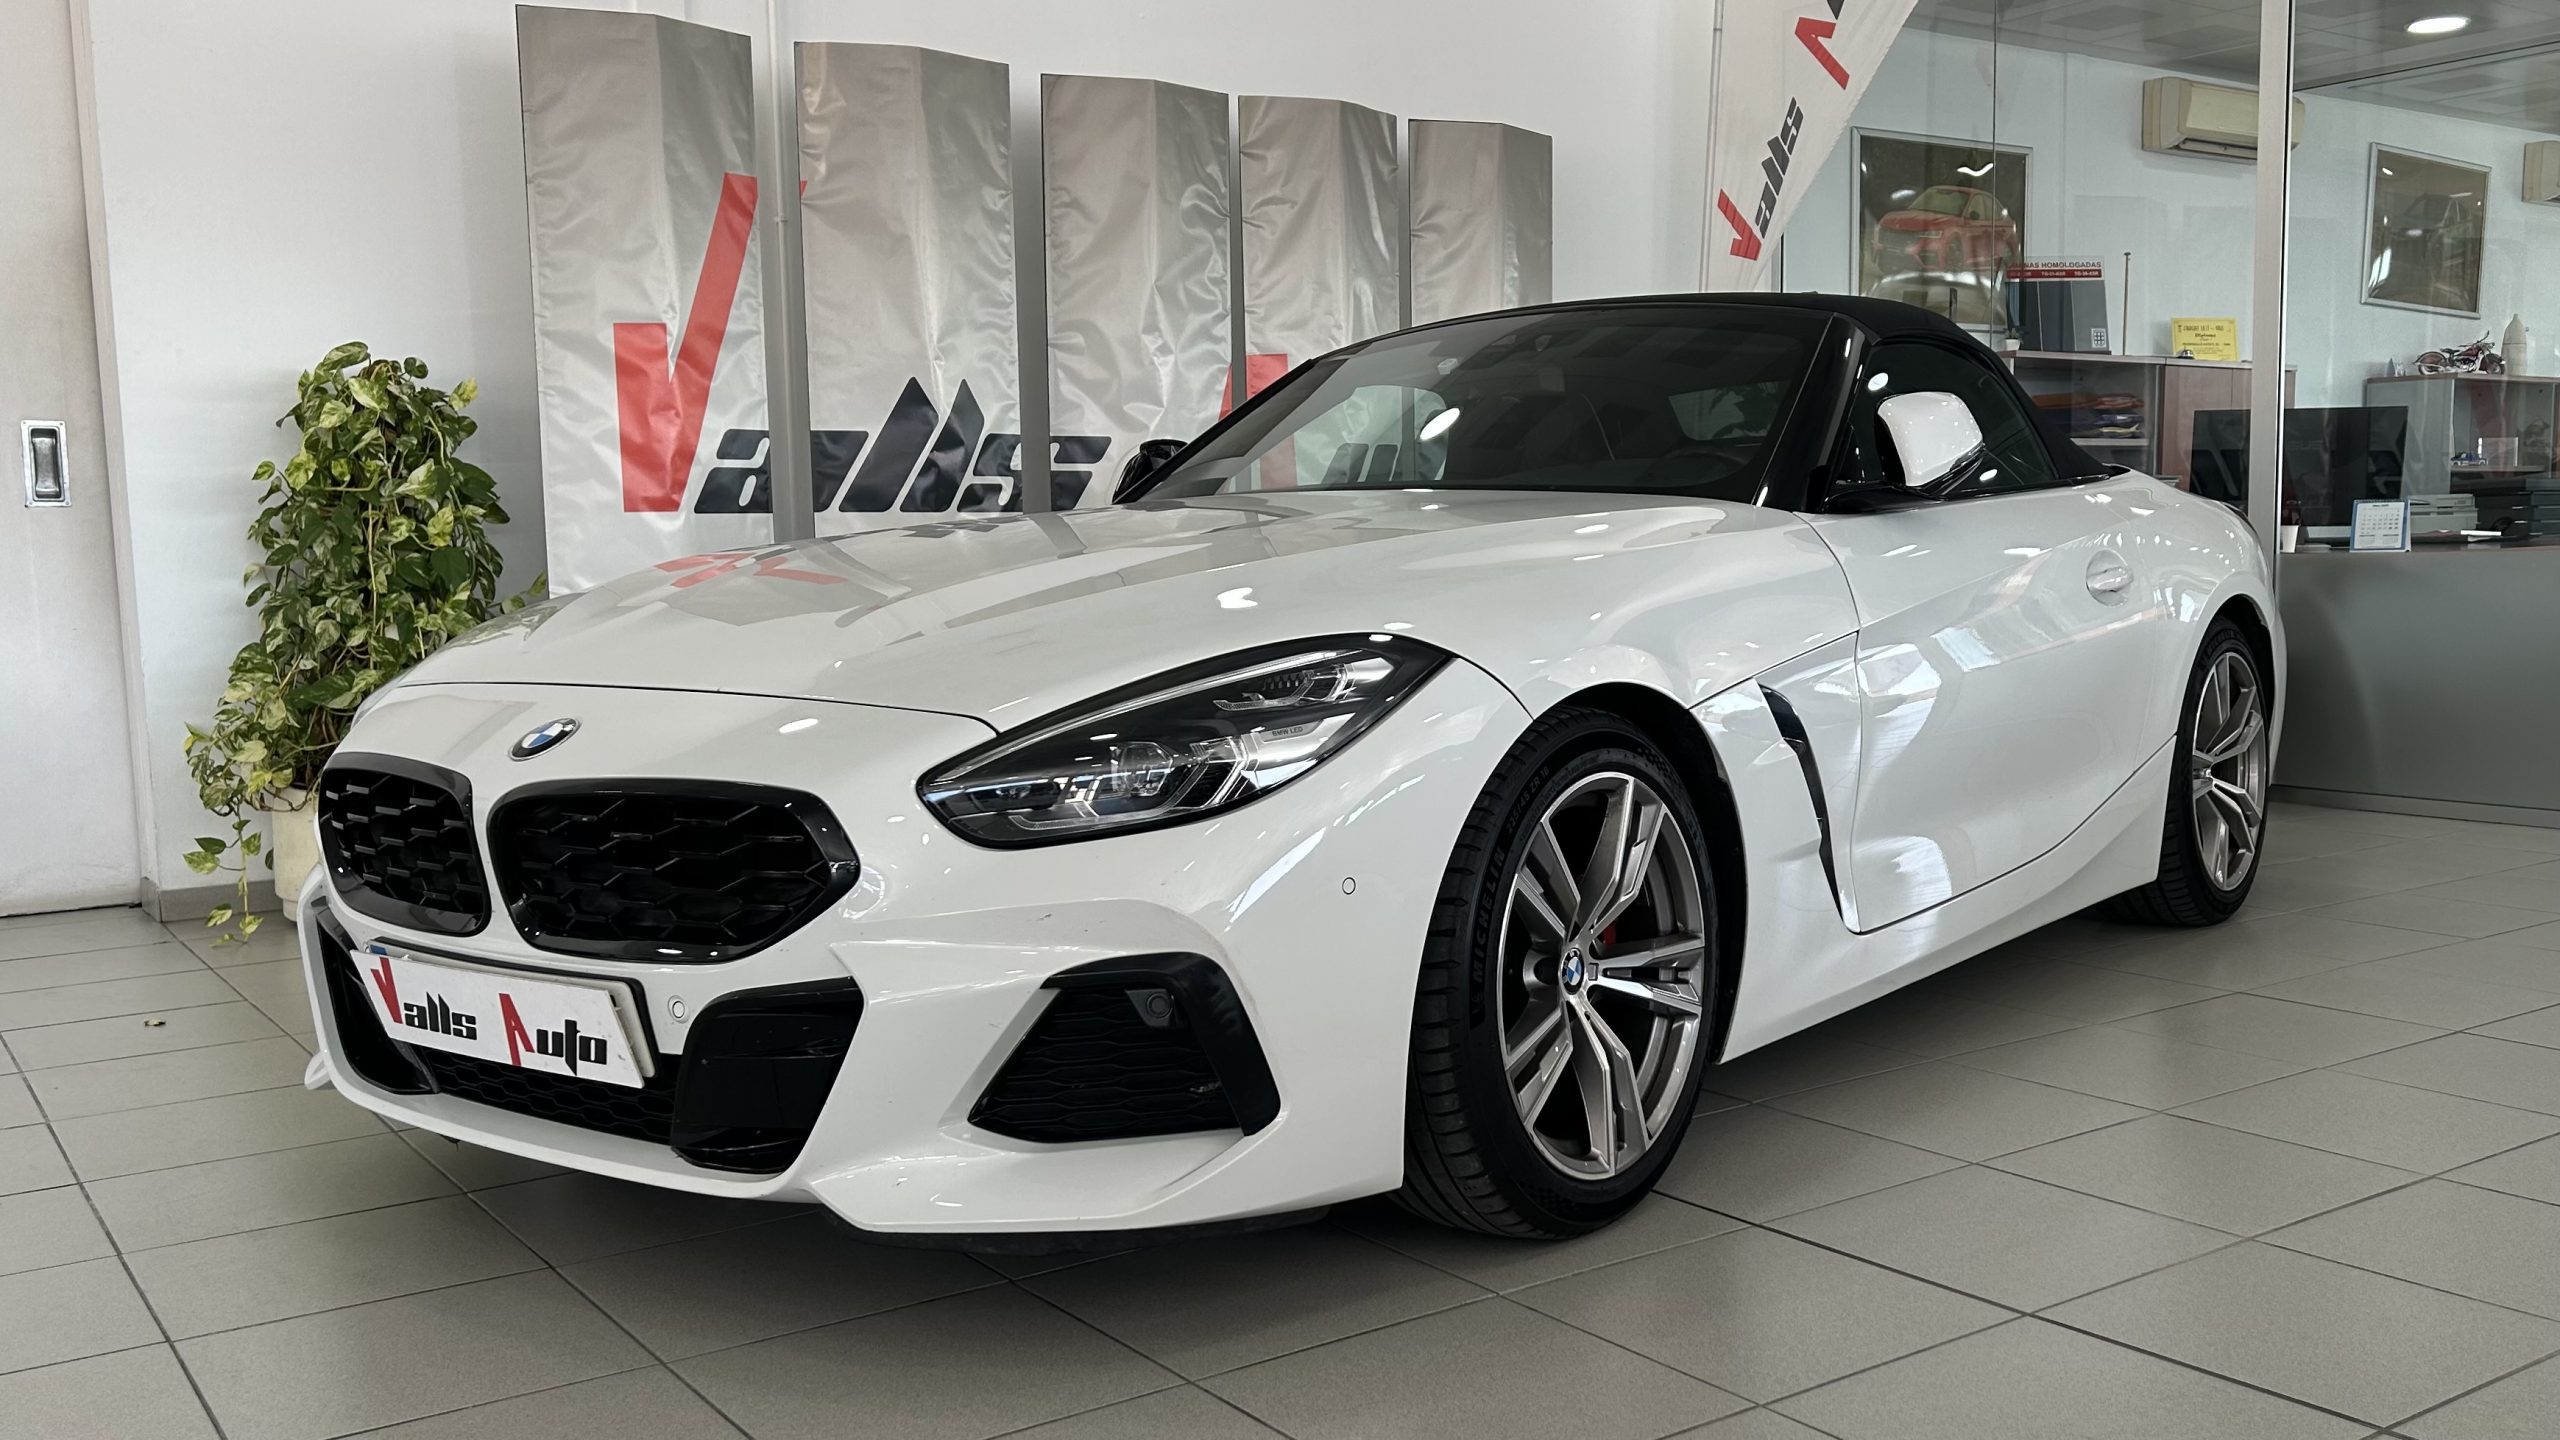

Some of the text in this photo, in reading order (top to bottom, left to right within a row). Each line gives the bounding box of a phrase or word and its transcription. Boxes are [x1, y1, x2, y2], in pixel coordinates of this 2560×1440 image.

[1717, 96, 1804, 261] Valls
[2041, 261, 2101, 269] HOMOLOGADAS
[613, 172, 1111, 514] Valls
[1272, 726, 1304, 737] BMW LED
[1472, 851, 1506, 985] MICHELIN
[1528, 777, 1541, 794] ZR
[370, 957, 608, 1077] Valls Auto
